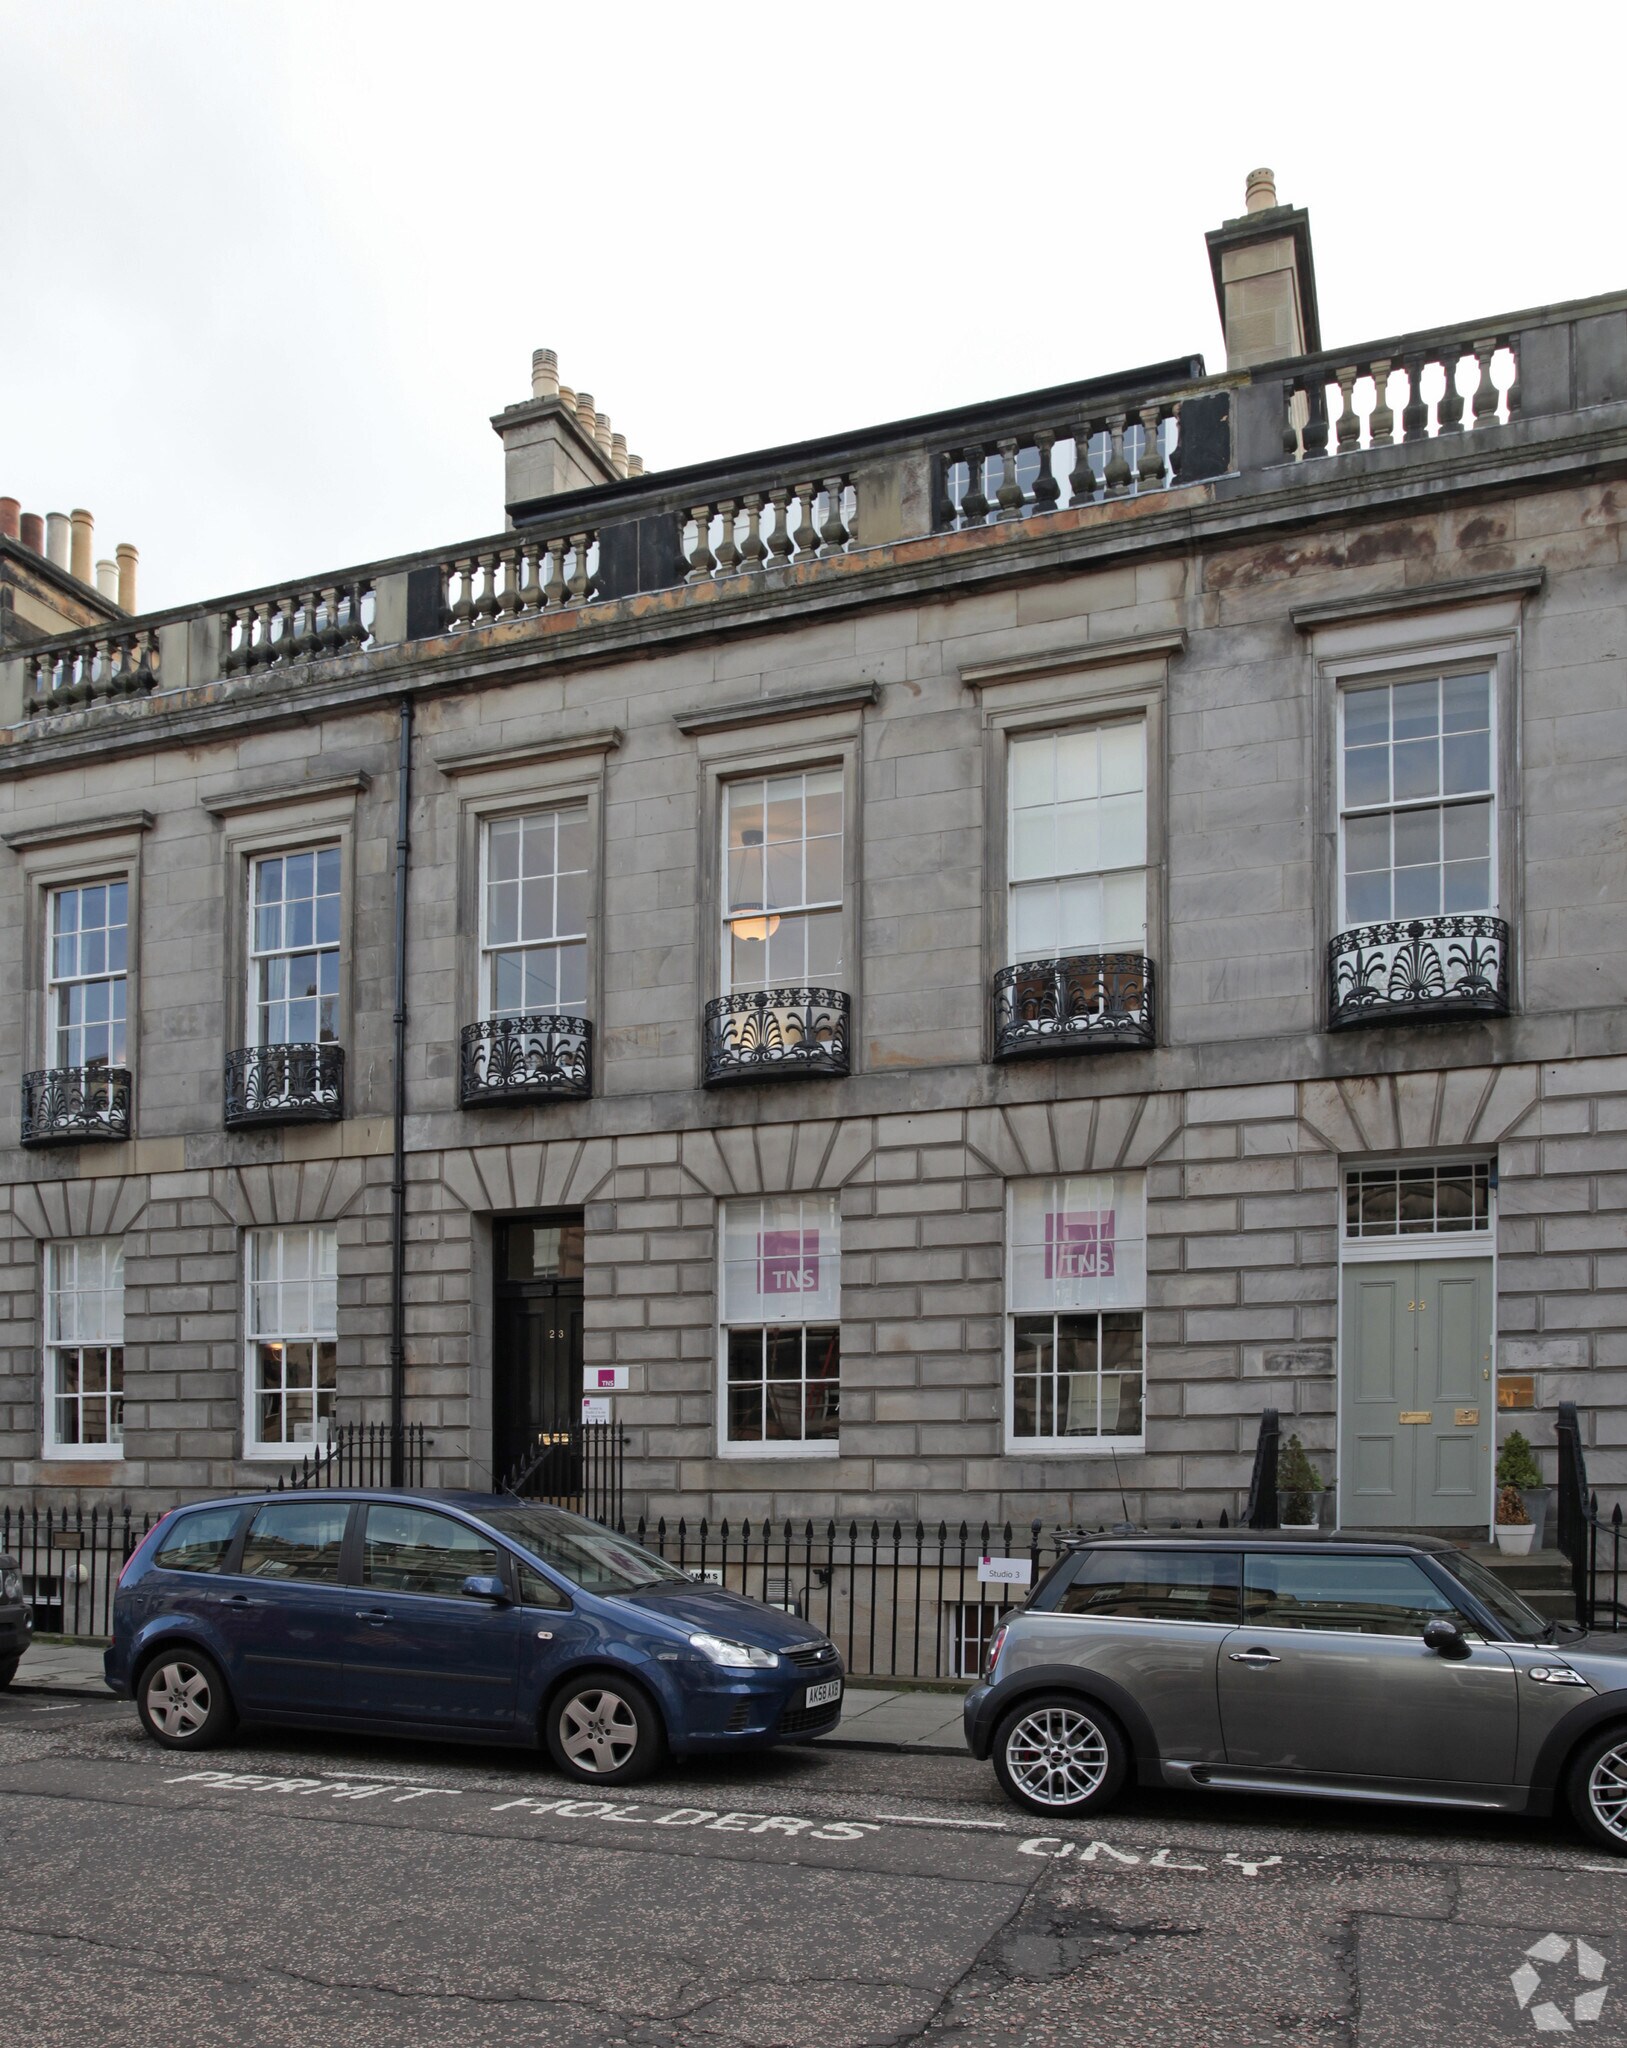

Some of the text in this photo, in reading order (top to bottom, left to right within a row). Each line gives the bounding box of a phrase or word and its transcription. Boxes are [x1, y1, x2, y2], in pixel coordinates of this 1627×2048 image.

[1062, 1252, 1110, 1273] TNS
[772, 1269, 815, 1289] TNS
[1407, 1300, 1426, 1312] 25
[549, 1329, 564, 1339] 23
[989, 1569, 1021, 1579] Studio 3
[809, 1681, 839, 1704] AK58 AXB
[164, 1771, 1283, 1876] PERMIT HOLDERS ONLY
